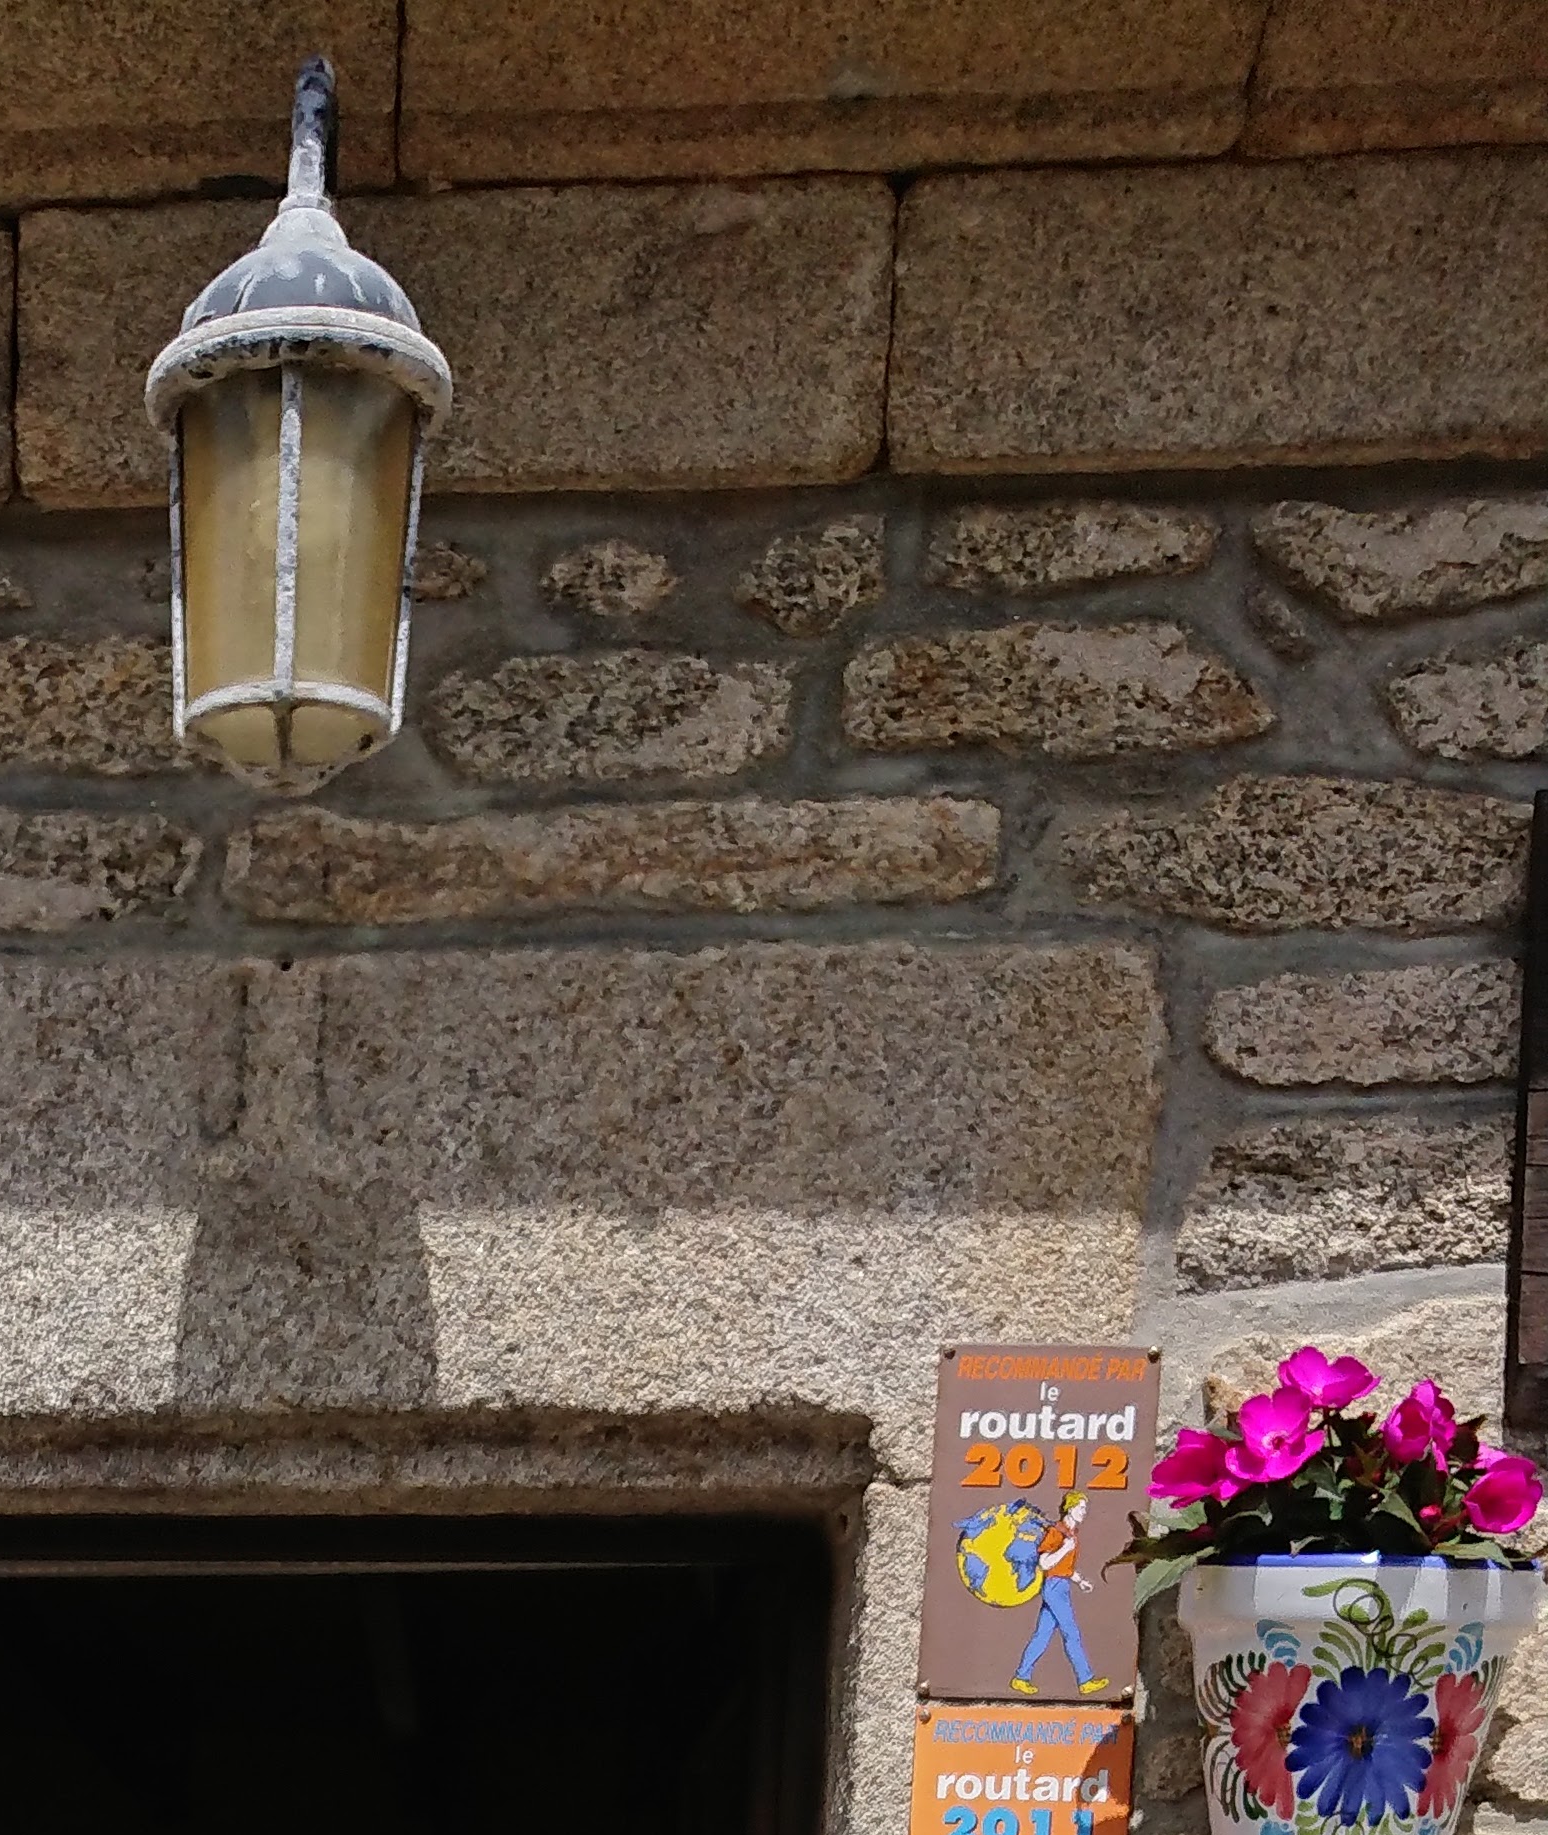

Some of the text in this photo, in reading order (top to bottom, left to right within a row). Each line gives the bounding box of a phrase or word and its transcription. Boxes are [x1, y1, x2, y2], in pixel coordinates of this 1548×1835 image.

[957, 1353, 1148, 1381] RECOMMANDÉ PAR
[1040, 1381, 1060, 1401] le
[959, 1405, 1136, 1441] routard
[961, 1443, 1129, 1490] 2012
[933, 1717, 1119, 1745] RECOMMANDÉ PAR
[1014, 1746, 1034, 1764] le
[936, 1768, 1109, 1803] routard
